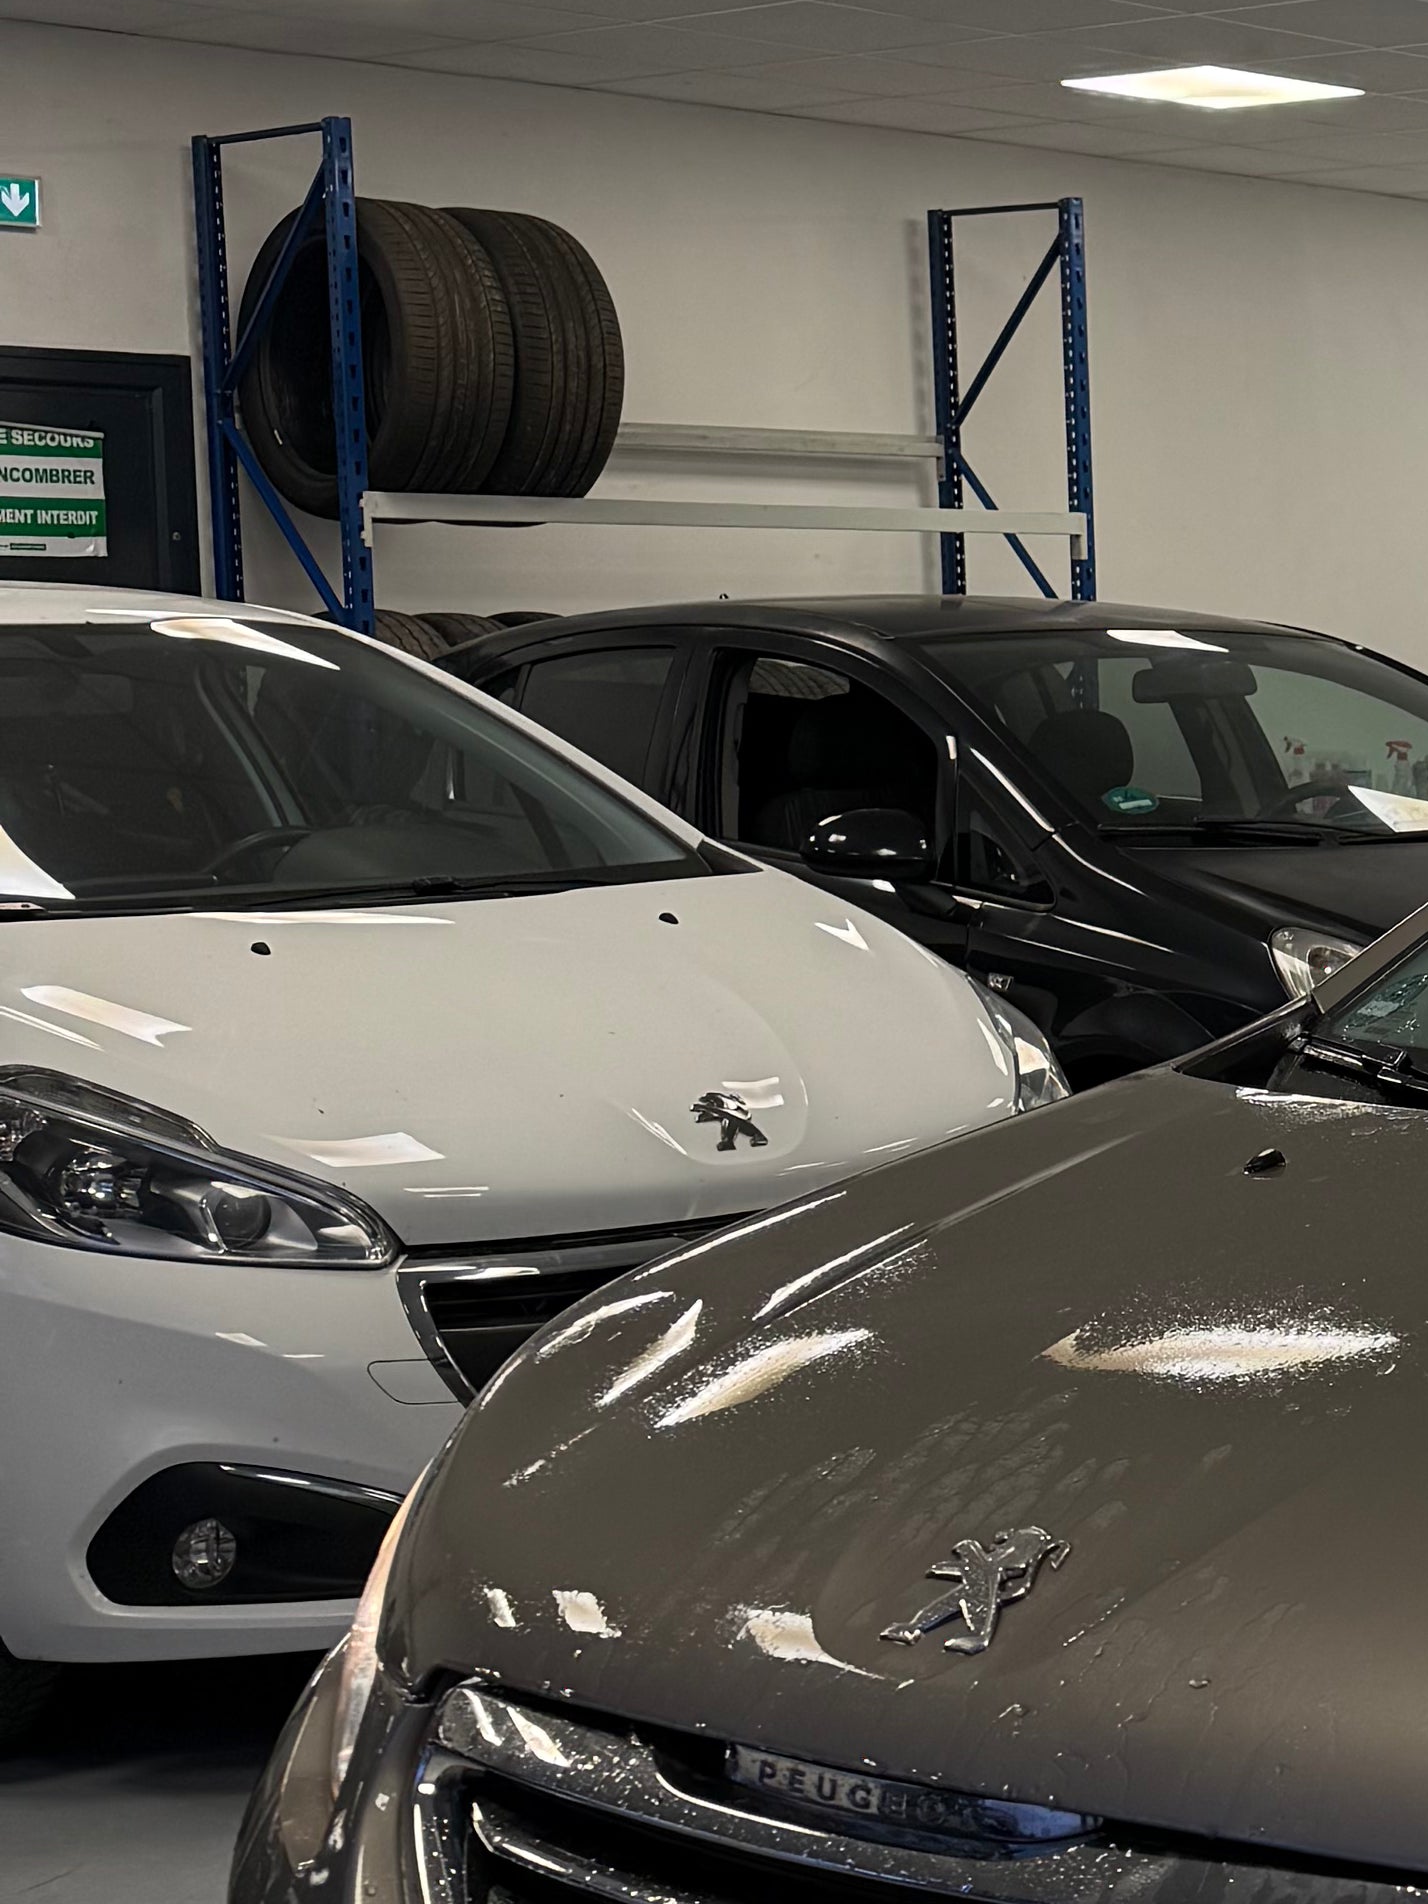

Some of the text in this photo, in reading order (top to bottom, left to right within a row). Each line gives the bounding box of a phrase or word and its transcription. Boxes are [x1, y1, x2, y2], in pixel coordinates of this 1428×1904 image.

[11, 429, 94, 447] SECOURS
[37, 509, 98, 525] INTERDIT
[757, 1758, 978, 1834] PEUGEO
